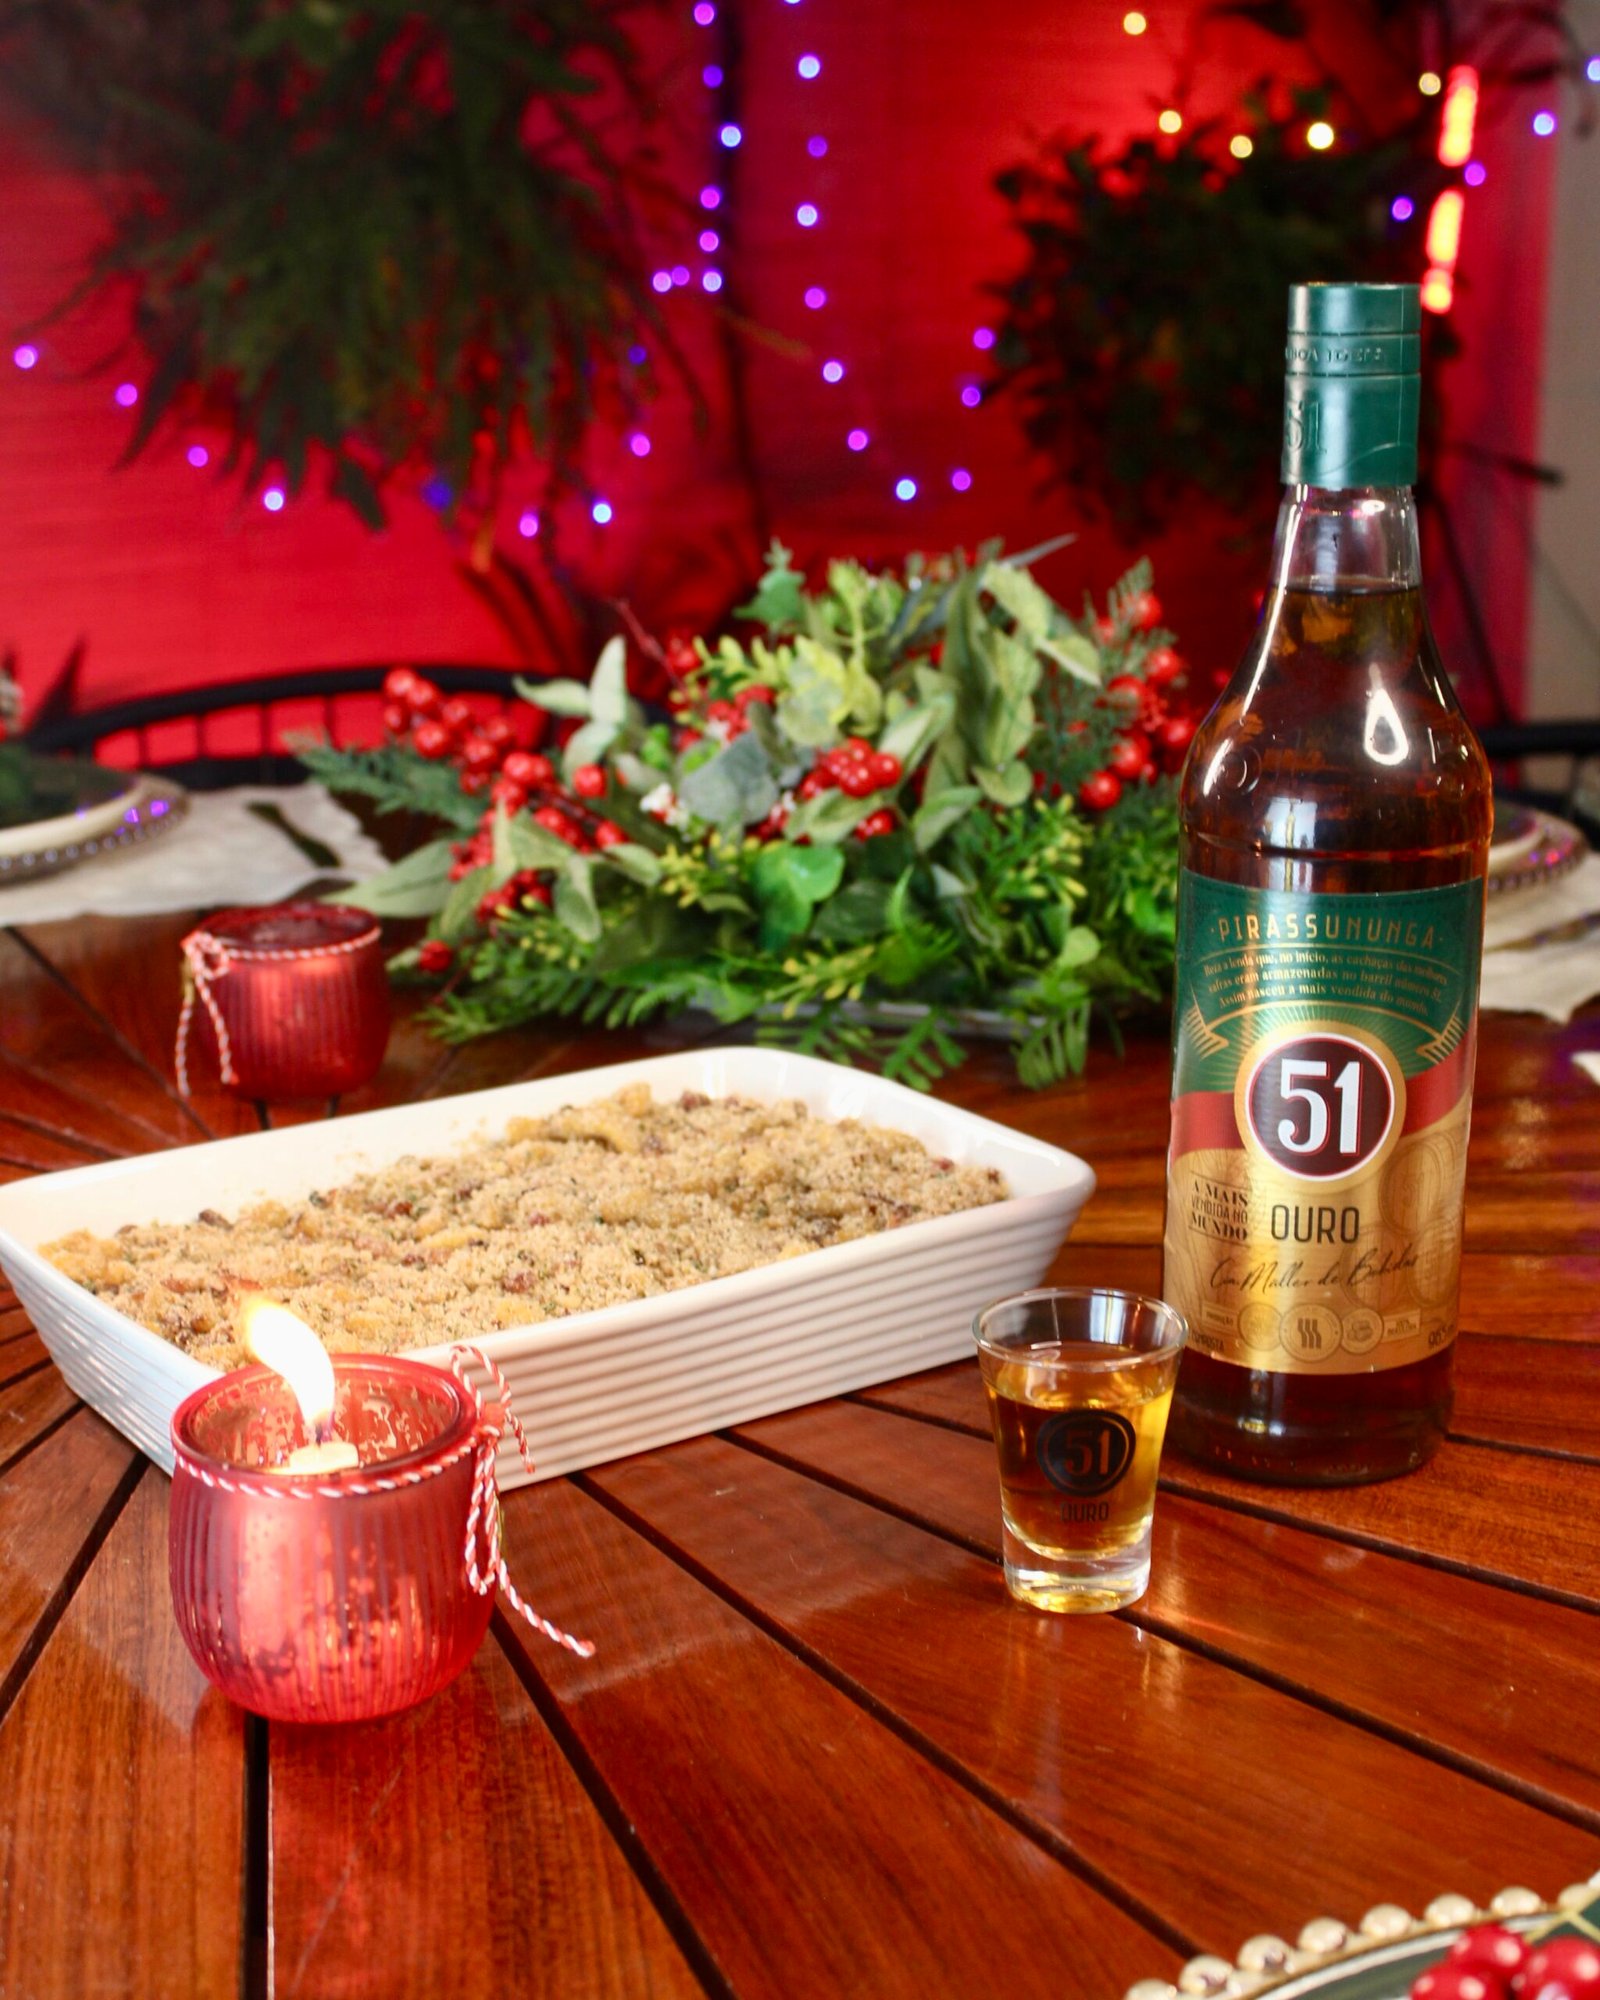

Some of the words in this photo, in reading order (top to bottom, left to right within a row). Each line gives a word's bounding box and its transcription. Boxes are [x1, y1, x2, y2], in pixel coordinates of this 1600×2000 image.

[1218, 913, 1435, 948] PIRASSUNUNGA
[1279, 952, 1293, 963] no
[1235, 971, 1259, 985] eram
[1262, 966, 1337, 981] armazenadas
[1342, 970, 1356, 981] no
[1247, 985, 1286, 999] nasceu
[1299, 982, 1326, 995] mais
[1331, 983, 1376, 1000] vendida
[1278, 1058, 1362, 1157] 51
[1192, 1194, 1230, 1221] VENDIDA
[1233, 1207, 1248, 1225] NO
[1205, 1183, 1248, 1207] MAIS
[1191, 1211, 1248, 1241] MUNDO
[1270, 1204, 1360, 1244] OURO
[1064, 1429, 1111, 1476] 51
[1060, 1500, 1109, 1523] OURO
